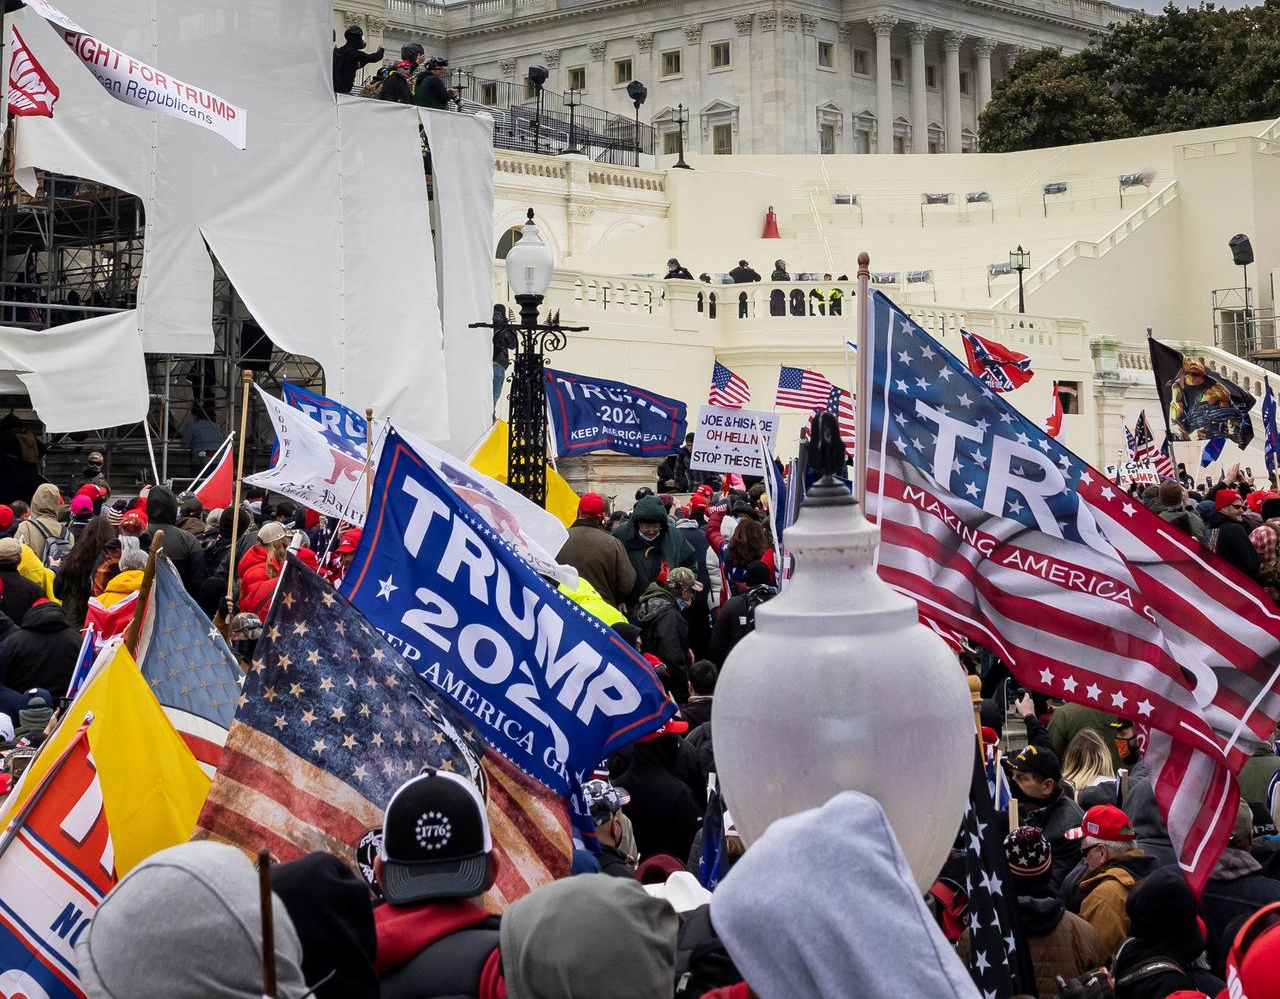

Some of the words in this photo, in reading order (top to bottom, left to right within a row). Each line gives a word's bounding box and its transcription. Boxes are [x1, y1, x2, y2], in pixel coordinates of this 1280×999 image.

[64, 31, 123, 70] FIGHT
[128, 58, 168, 90] FOR
[173, 81, 236, 122] TRUMP
[125, 80, 213, 125] Republicans
[701, 414, 723, 427] JOE
[724, 416, 732, 427] &
[732, 417, 750, 429] HIS
[571, 427, 599, 440] KEEP
[706, 429, 721, 441] OH
[724, 432, 750, 444] HELL
[693, 451, 721, 464] STOP
[724, 453, 743, 466] THE
[1107, 462, 1151, 475] FGHT
[902, 486, 996, 558] MAKING
[1003, 550, 1133, 606] AMERICA
[400, 475, 642, 727] TRUMP
[376, 626, 421, 662] EEP
[420, 661, 536, 756] AMERICA
[421, 825, 446, 837] 1776
